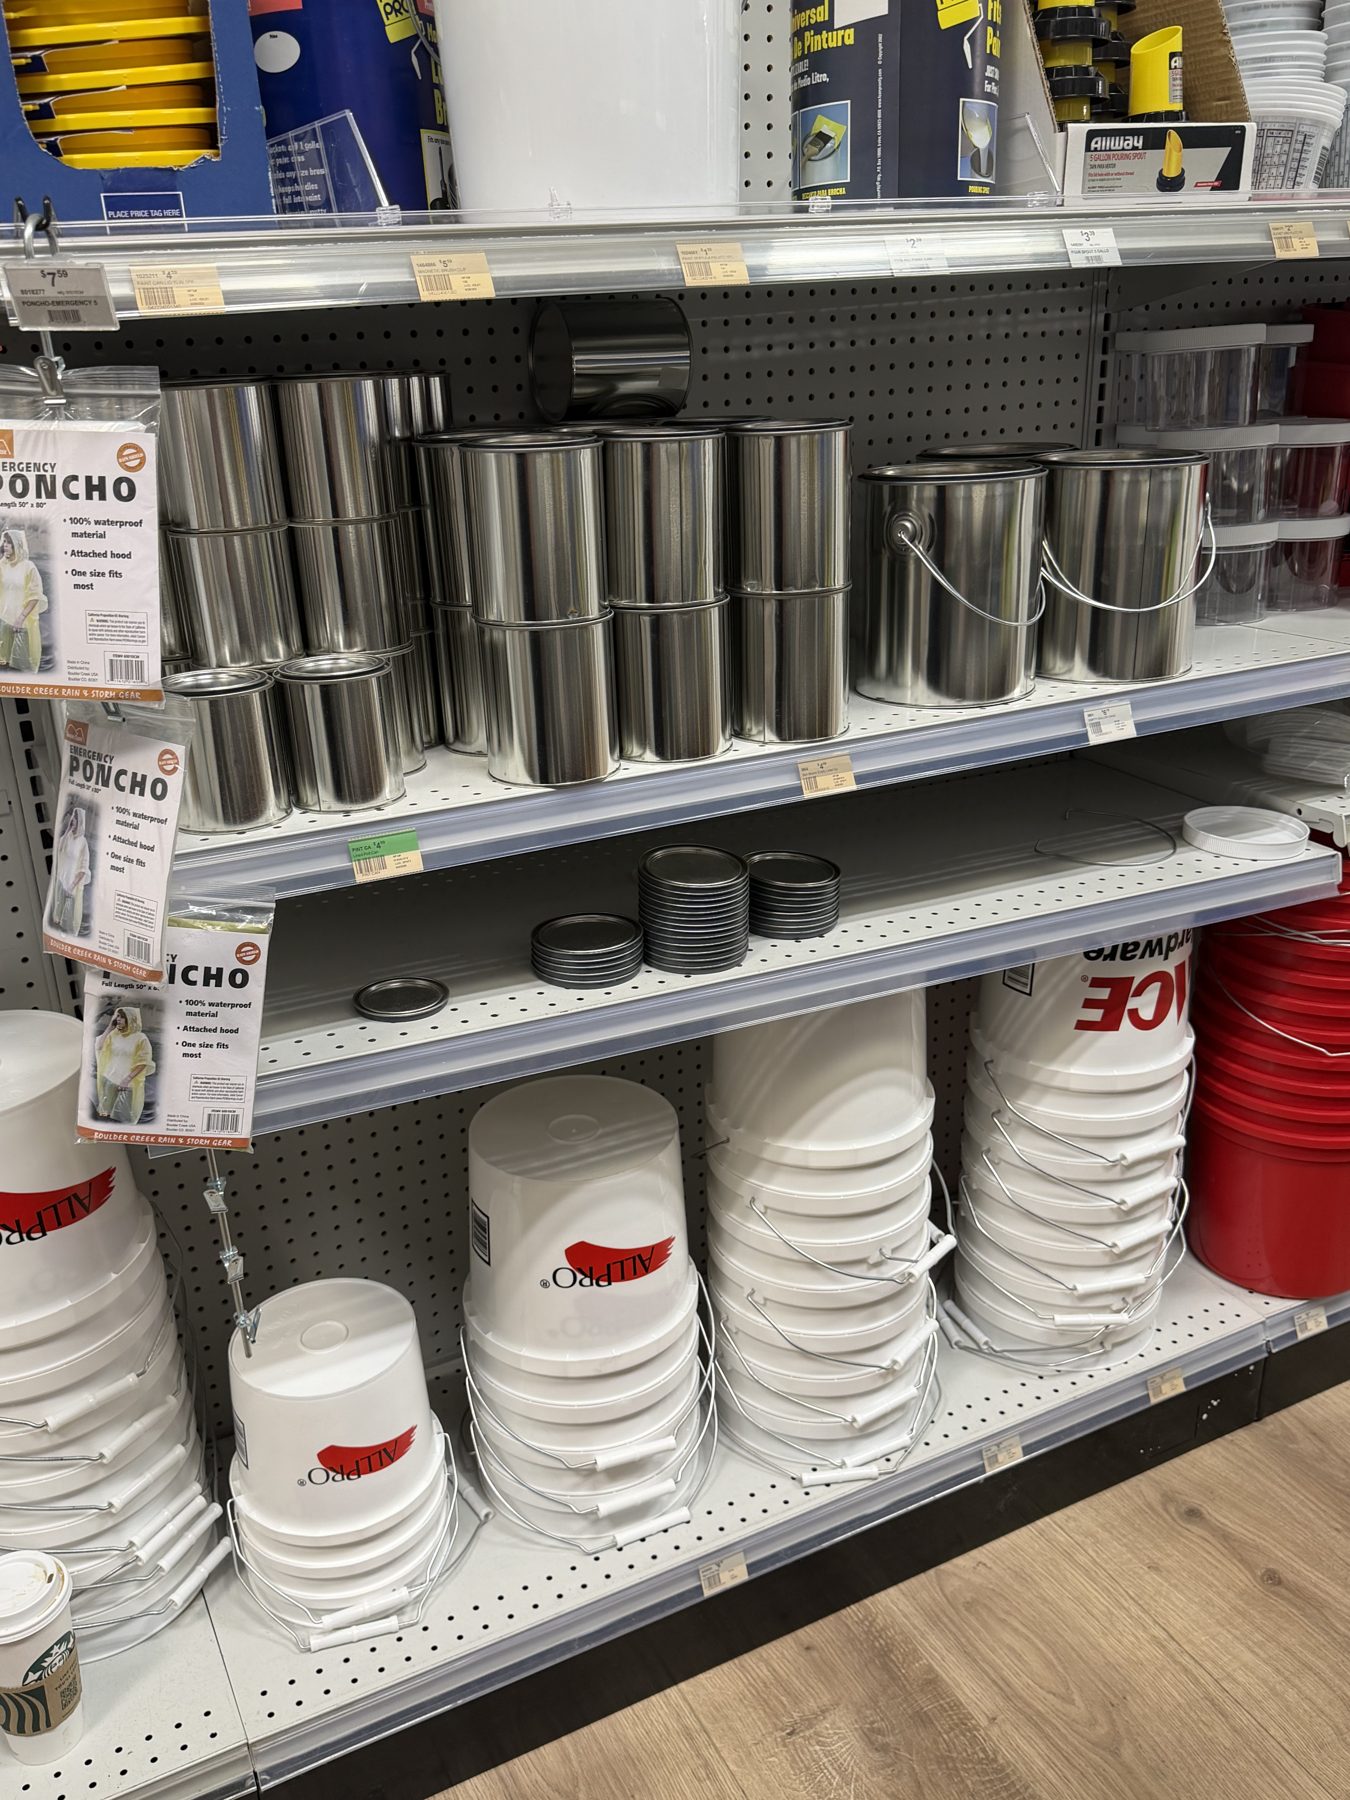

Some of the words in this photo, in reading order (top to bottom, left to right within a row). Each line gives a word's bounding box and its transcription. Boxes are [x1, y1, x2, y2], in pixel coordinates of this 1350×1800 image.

[804, 28, 855, 54] Pintura
[1090, 135, 1144, 151] Allway
[1112, 152, 1132, 161] POURING
[1132, 151, 1147, 160] SPOUT
[108, 210, 129, 218] PLACE
[0, 501, 17, 509] ength
[69, 517, 92, 526] 100%
[94, 518, 144, 529] waterproof
[71, 530, 107, 539] material
[70, 549, 108, 559] Attached
[110, 550, 132, 560] hood
[71, 569, 87, 578] One
[89, 569, 106, 578] size
[109, 569, 123, 579] fits
[73, 582, 94, 590] most
[0, 684, 31, 695] OULDER
[33, 685, 59, 696] CREEK
[61, 687, 81, 697] RAIN
[91, 687, 116, 699] STORM
[118, 689, 142, 700] GEAR
[69, 744, 115, 764] EMERGENCY
[69, 755, 169, 801] PONCHO
[115, 805, 131, 816] 100%
[132, 811, 168, 826] waterproof
[115, 819, 140, 831] material
[112, 834, 138, 848] Attached
[139, 841, 155, 852] hood
[110, 851, 122, 861] One
[123, 855, 135, 864] size
[136, 858, 146, 868] fits
[110, 864, 125, 874] most
[72, 947, 92, 959] CREEK
[93, 953, 107, 964] RAIN
[113, 961, 131, 972] STORM
[131, 966, 147, 978] GEAR
[114, 982, 135, 990] Length
[185, 999, 206, 1007] 100%
[208, 1001, 252, 1009] waterproof
[186, 1010, 218, 1018] material
[182, 1025, 217, 1034] Attached
[219, 1026, 239, 1034] hood
[199, 1041, 214, 1049] size
[216, 1041, 229, 1050] fits
[94, 1131, 128, 1142] BOULDER
[130, 1133, 157, 1144] CREEK
[158, 1135, 176, 1144] RAIN
[186, 1137, 210, 1146] STORM
[212, 1138, 233, 1147] GEAR
[0, 1181, 93, 1246] ALLPR
